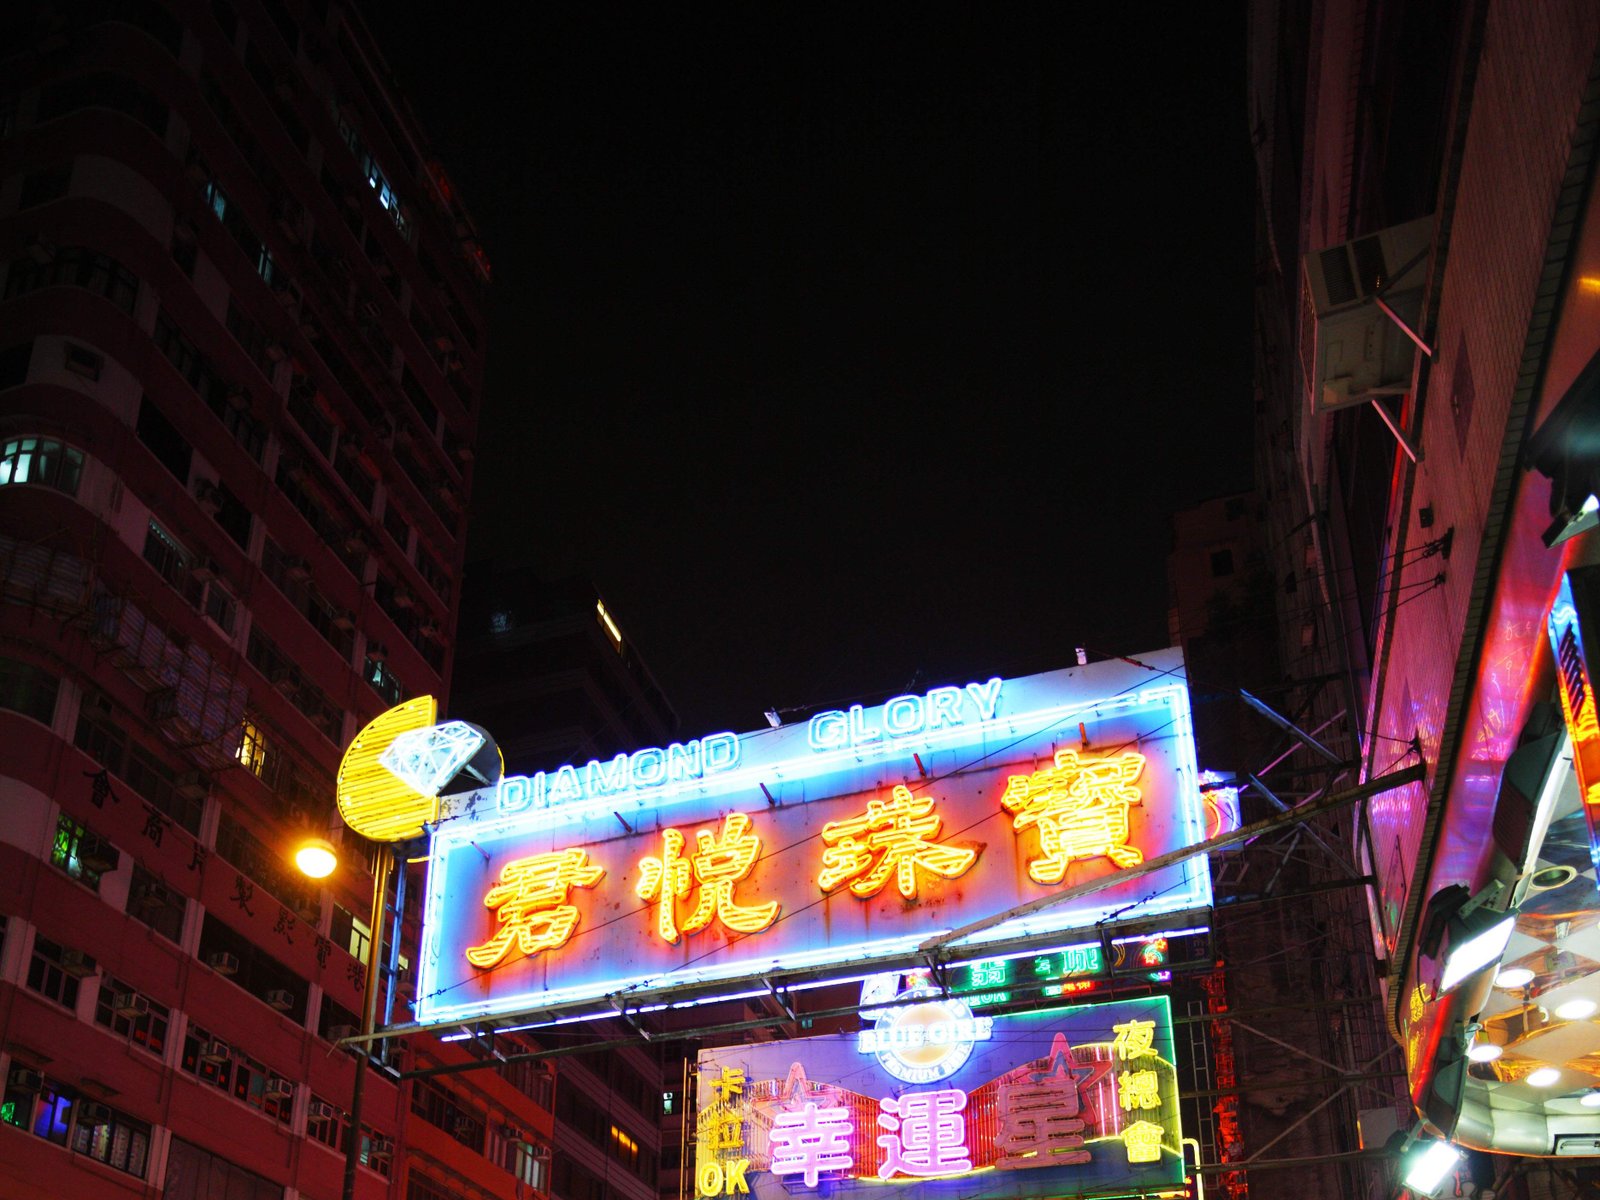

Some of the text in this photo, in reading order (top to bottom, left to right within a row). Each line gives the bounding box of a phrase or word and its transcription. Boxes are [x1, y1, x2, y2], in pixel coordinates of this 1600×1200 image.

[496, 677, 1003, 815] DIAMOND GLORY
[858, 1022, 925, 1053] BLUE
[1112, 1019, 1168, 1164] 夜總會
[768, 1088, 1093, 1188] 幸運星
